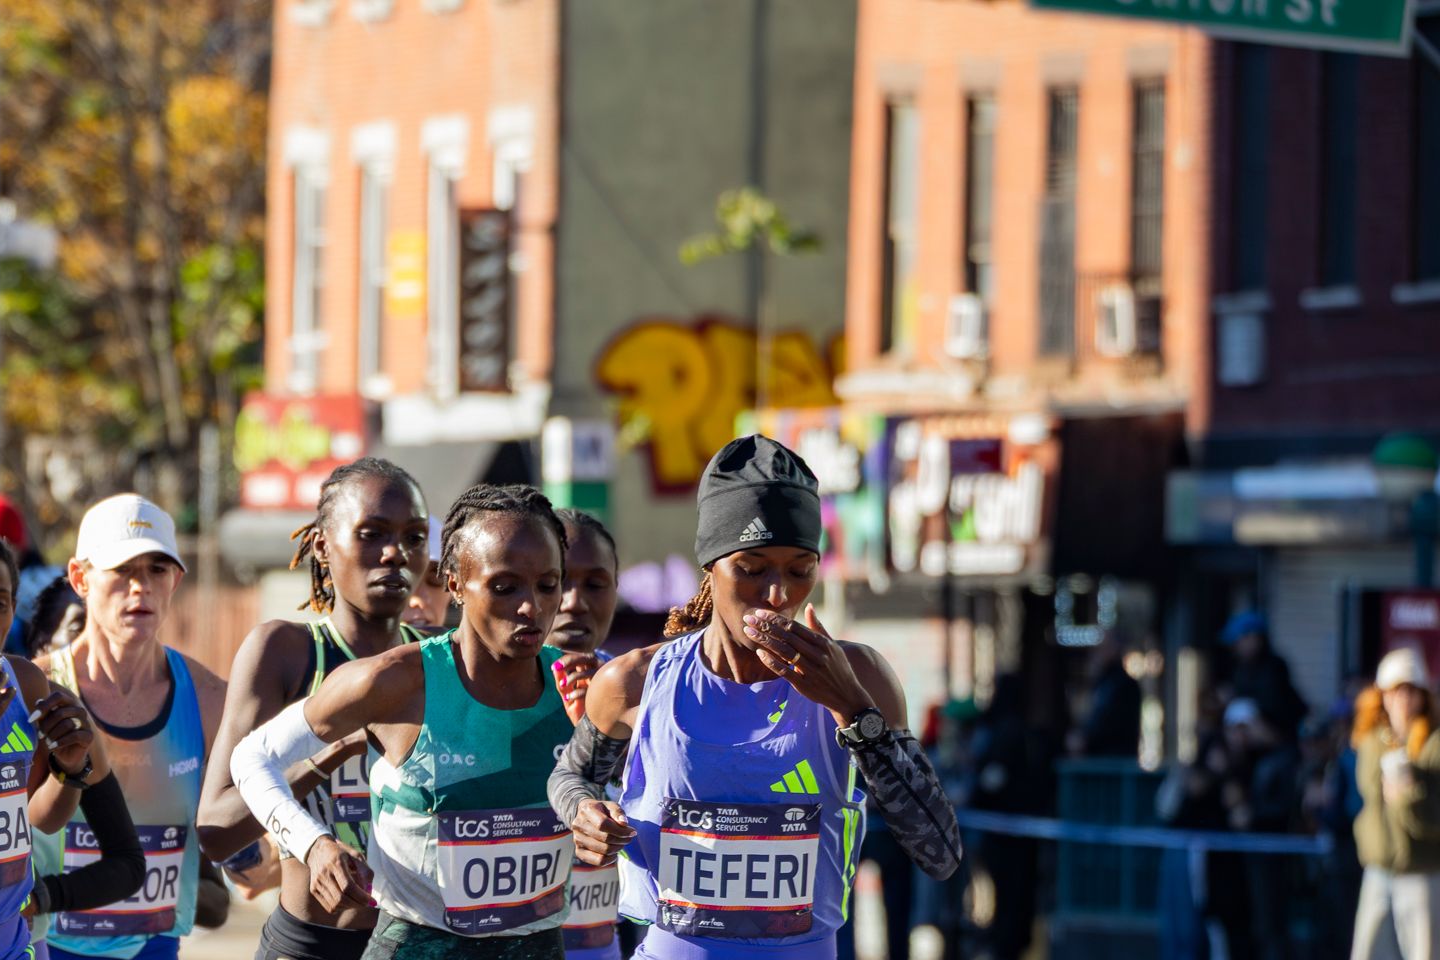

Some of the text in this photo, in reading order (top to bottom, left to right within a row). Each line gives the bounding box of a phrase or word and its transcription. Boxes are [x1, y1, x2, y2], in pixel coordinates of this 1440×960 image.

[739, 530, 773, 542] adidas
[0, 780, 20, 790] TATA
[678, 804, 713, 829] tcs
[717, 808, 739, 816] TATA
[493, 814, 513, 822] TATA
[716, 816, 768, 825] CONSULTANCY
[455, 816, 489, 838] tcs
[492, 819, 541, 830] CONSULTANCY
[716, 823, 749, 832] SERVICES
[781, 823, 807, 832] TATA
[492, 827, 523, 837] SERVICES
[463, 848, 561, 900] OBIRI
[669, 847, 809, 899] TEFERI
